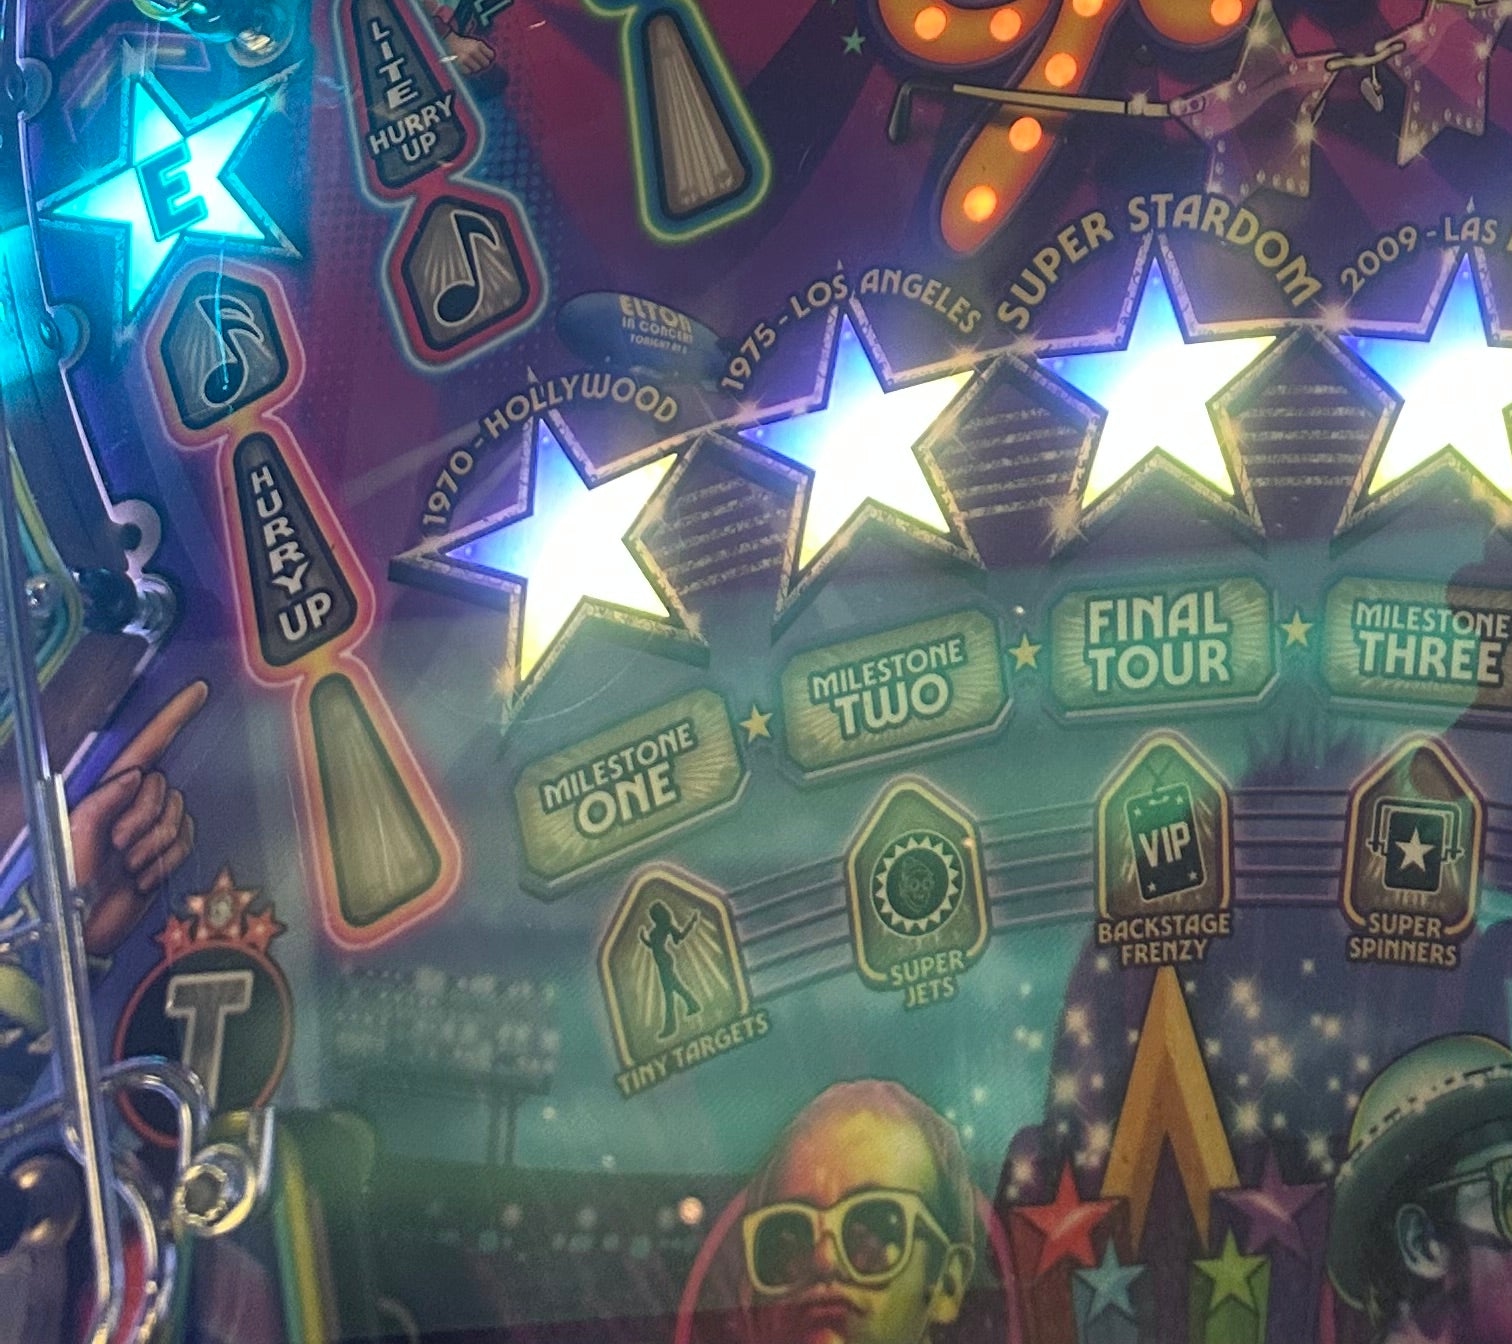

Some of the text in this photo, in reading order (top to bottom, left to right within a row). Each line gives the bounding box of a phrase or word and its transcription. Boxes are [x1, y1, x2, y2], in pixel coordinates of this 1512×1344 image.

[370, 18, 419, 107] LITE
[369, 95, 455, 155] HURRY
[403, 130, 438, 162] UP
[134, 144, 209, 242] E
[998, 193, 1325, 332] SUPER STARDOM
[1341, 227, 1419, 295] 2009
[1444, 217, 1498, 245] LAS
[720, 327, 777, 393] 1975
[790, 274, 849, 318] LOS
[859, 269, 983, 335] ANGELES
[422, 449, 475, 528] 1970
[484, 373, 679, 439] HOLLYWOOD
[250, 465, 309, 593] HURRY
[279, 592, 333, 643] UP
[1088, 592, 1229, 644] FINAL
[807, 637, 963, 702] MILESTONE
[1088, 642, 1231, 691] TOUR
[1357, 630, 1502, 684] THREE
[834, 678, 950, 741] TWO
[541, 718, 694, 811] MILESTONE
[574, 771, 680, 840] ONE
[1138, 820, 1192, 870] VIP
[1097, 913, 1231, 945] BACKSTAGE
[1121, 936, 1210, 965] FRENZY
[1348, 938, 1457, 968] SPINNERS
[1369, 914, 1442, 940] SUPER
[889, 949, 966, 988] SUPER
[904, 978, 956, 1009] JETS
[165, 969, 254, 1112] T
[616, 1010, 770, 1095] TINY TARGETS
